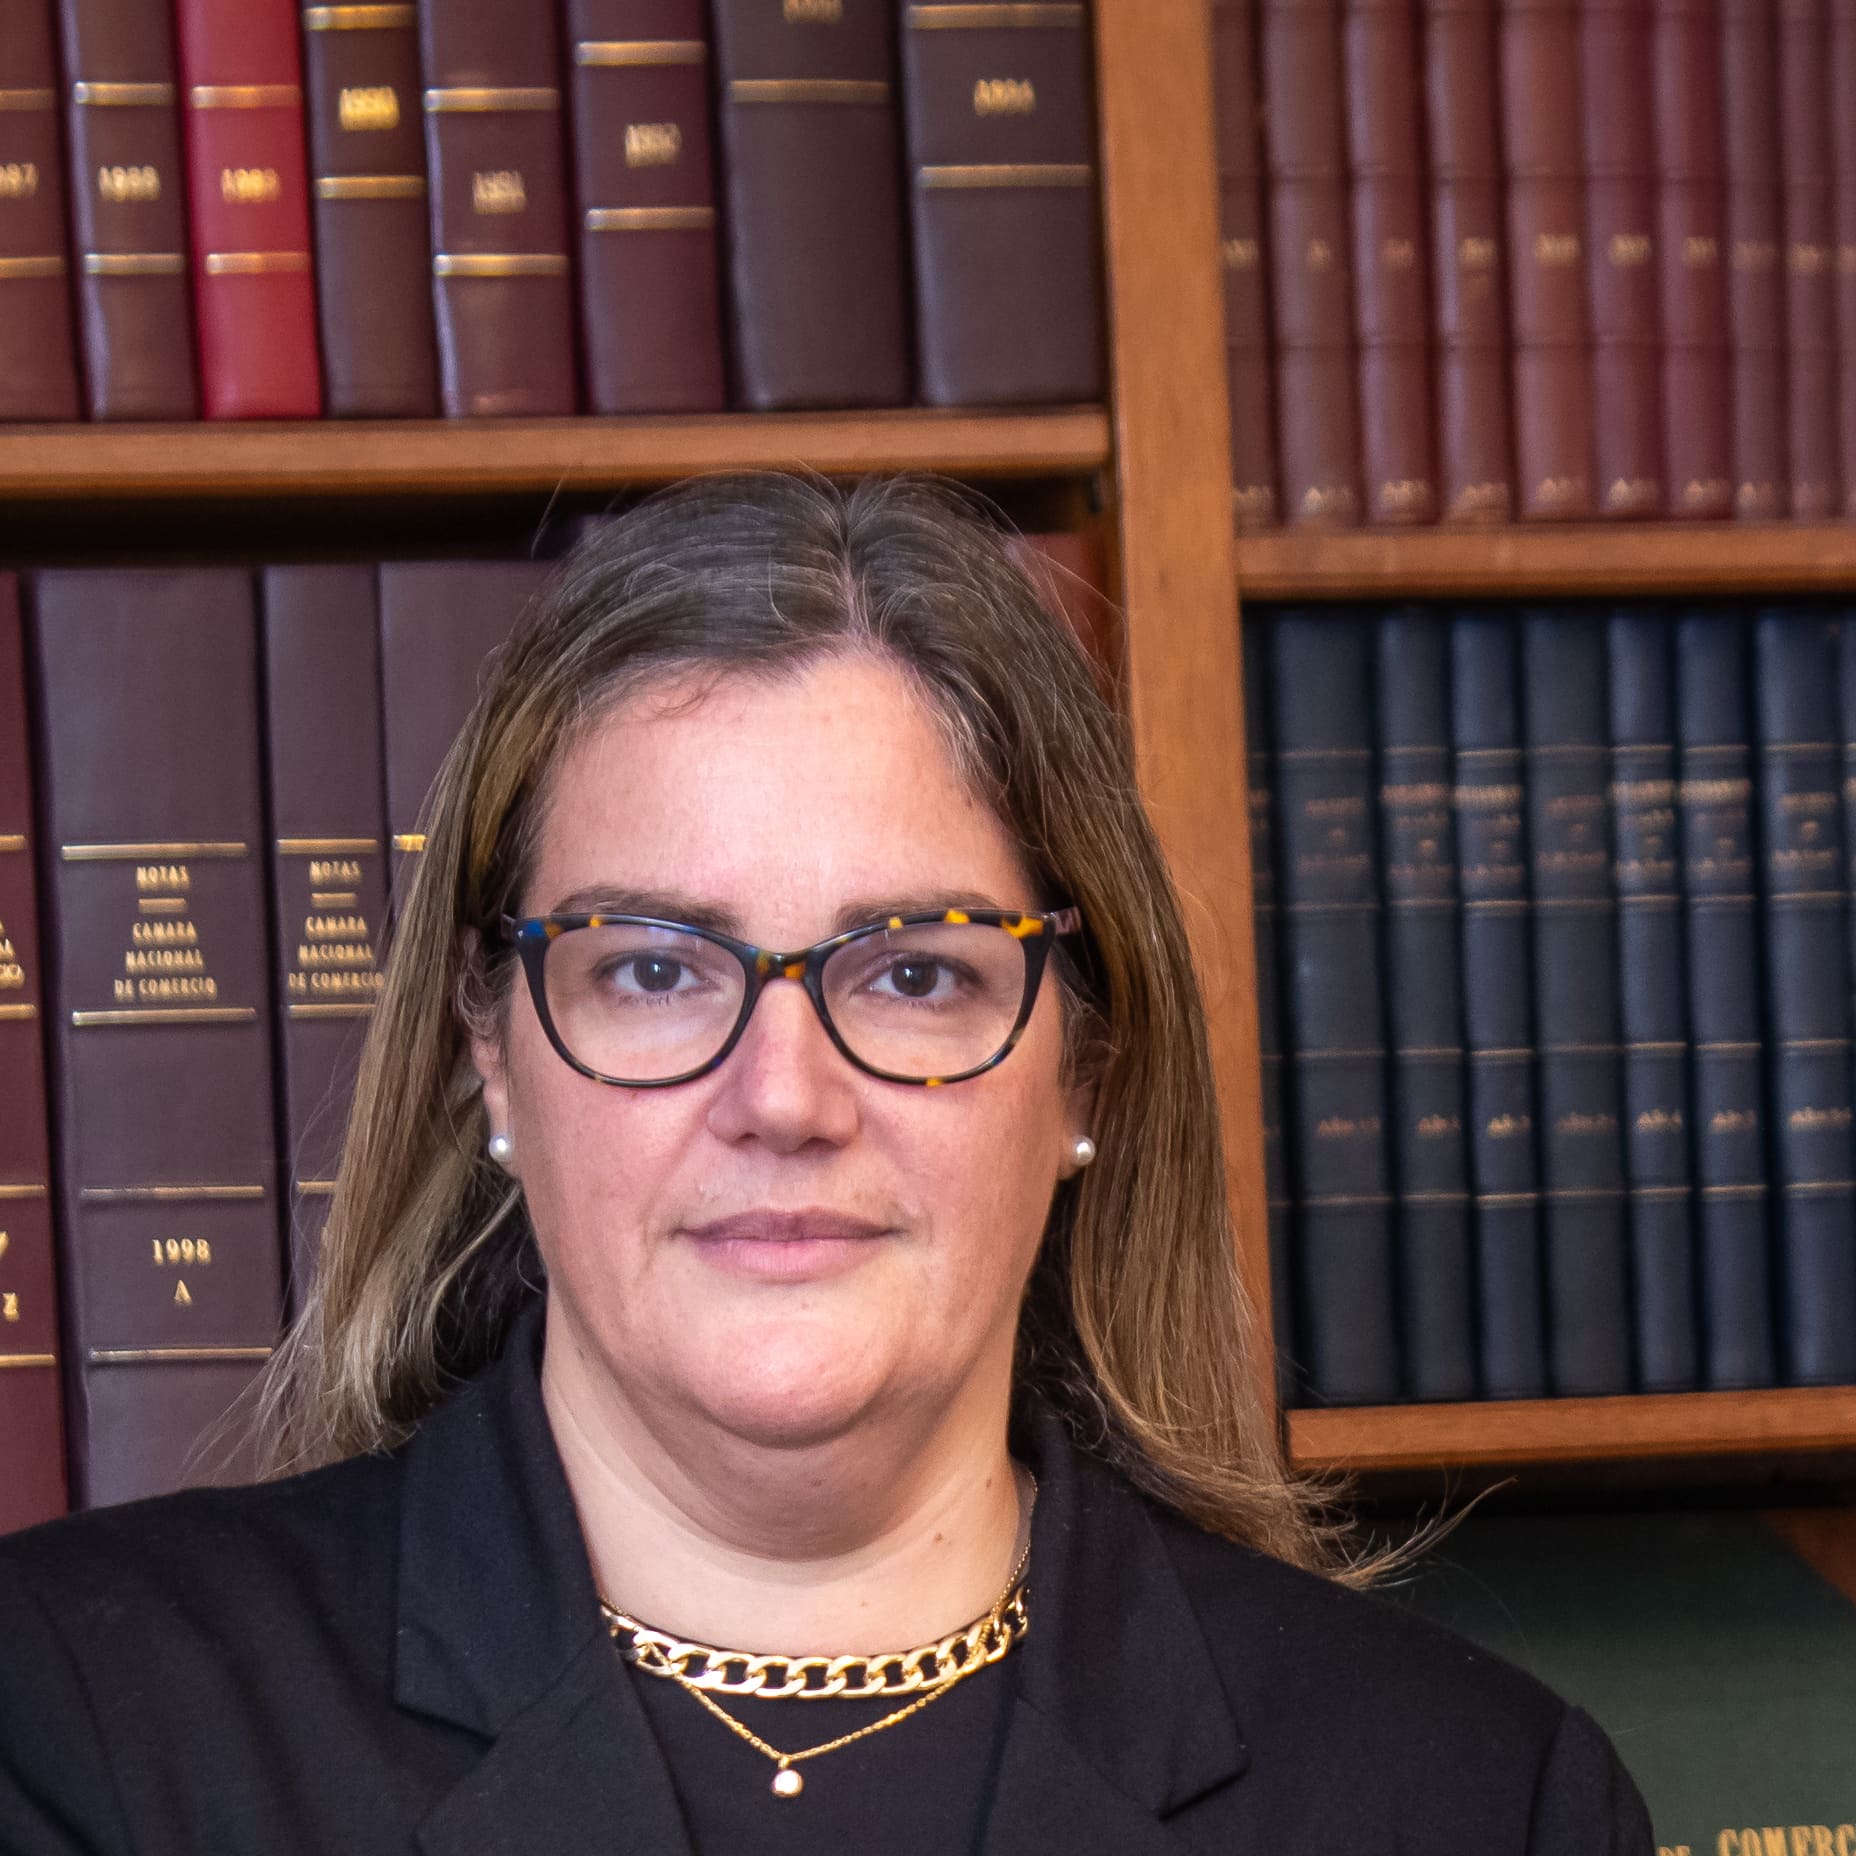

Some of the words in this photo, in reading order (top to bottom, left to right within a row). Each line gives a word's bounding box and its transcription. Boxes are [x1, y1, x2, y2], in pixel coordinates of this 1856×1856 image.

[136, 866, 190, 890] NOTAS
[309, 861, 360, 883] NOTAS
[132, 921, 197, 944] CAMARA
[305, 916, 367, 938] CAMARA
[125, 949, 204, 971] NACIONAL
[298, 945, 372, 966] NACIONAL
[115, 978, 134, 1000] DE
[139, 978, 217, 1000] COMERCIO
[289, 972, 307, 992] DE
[311, 972, 384, 994] COMERCIO
[152, 1238, 210, 1264] 1998
[174, 1281, 192, 1305] A
